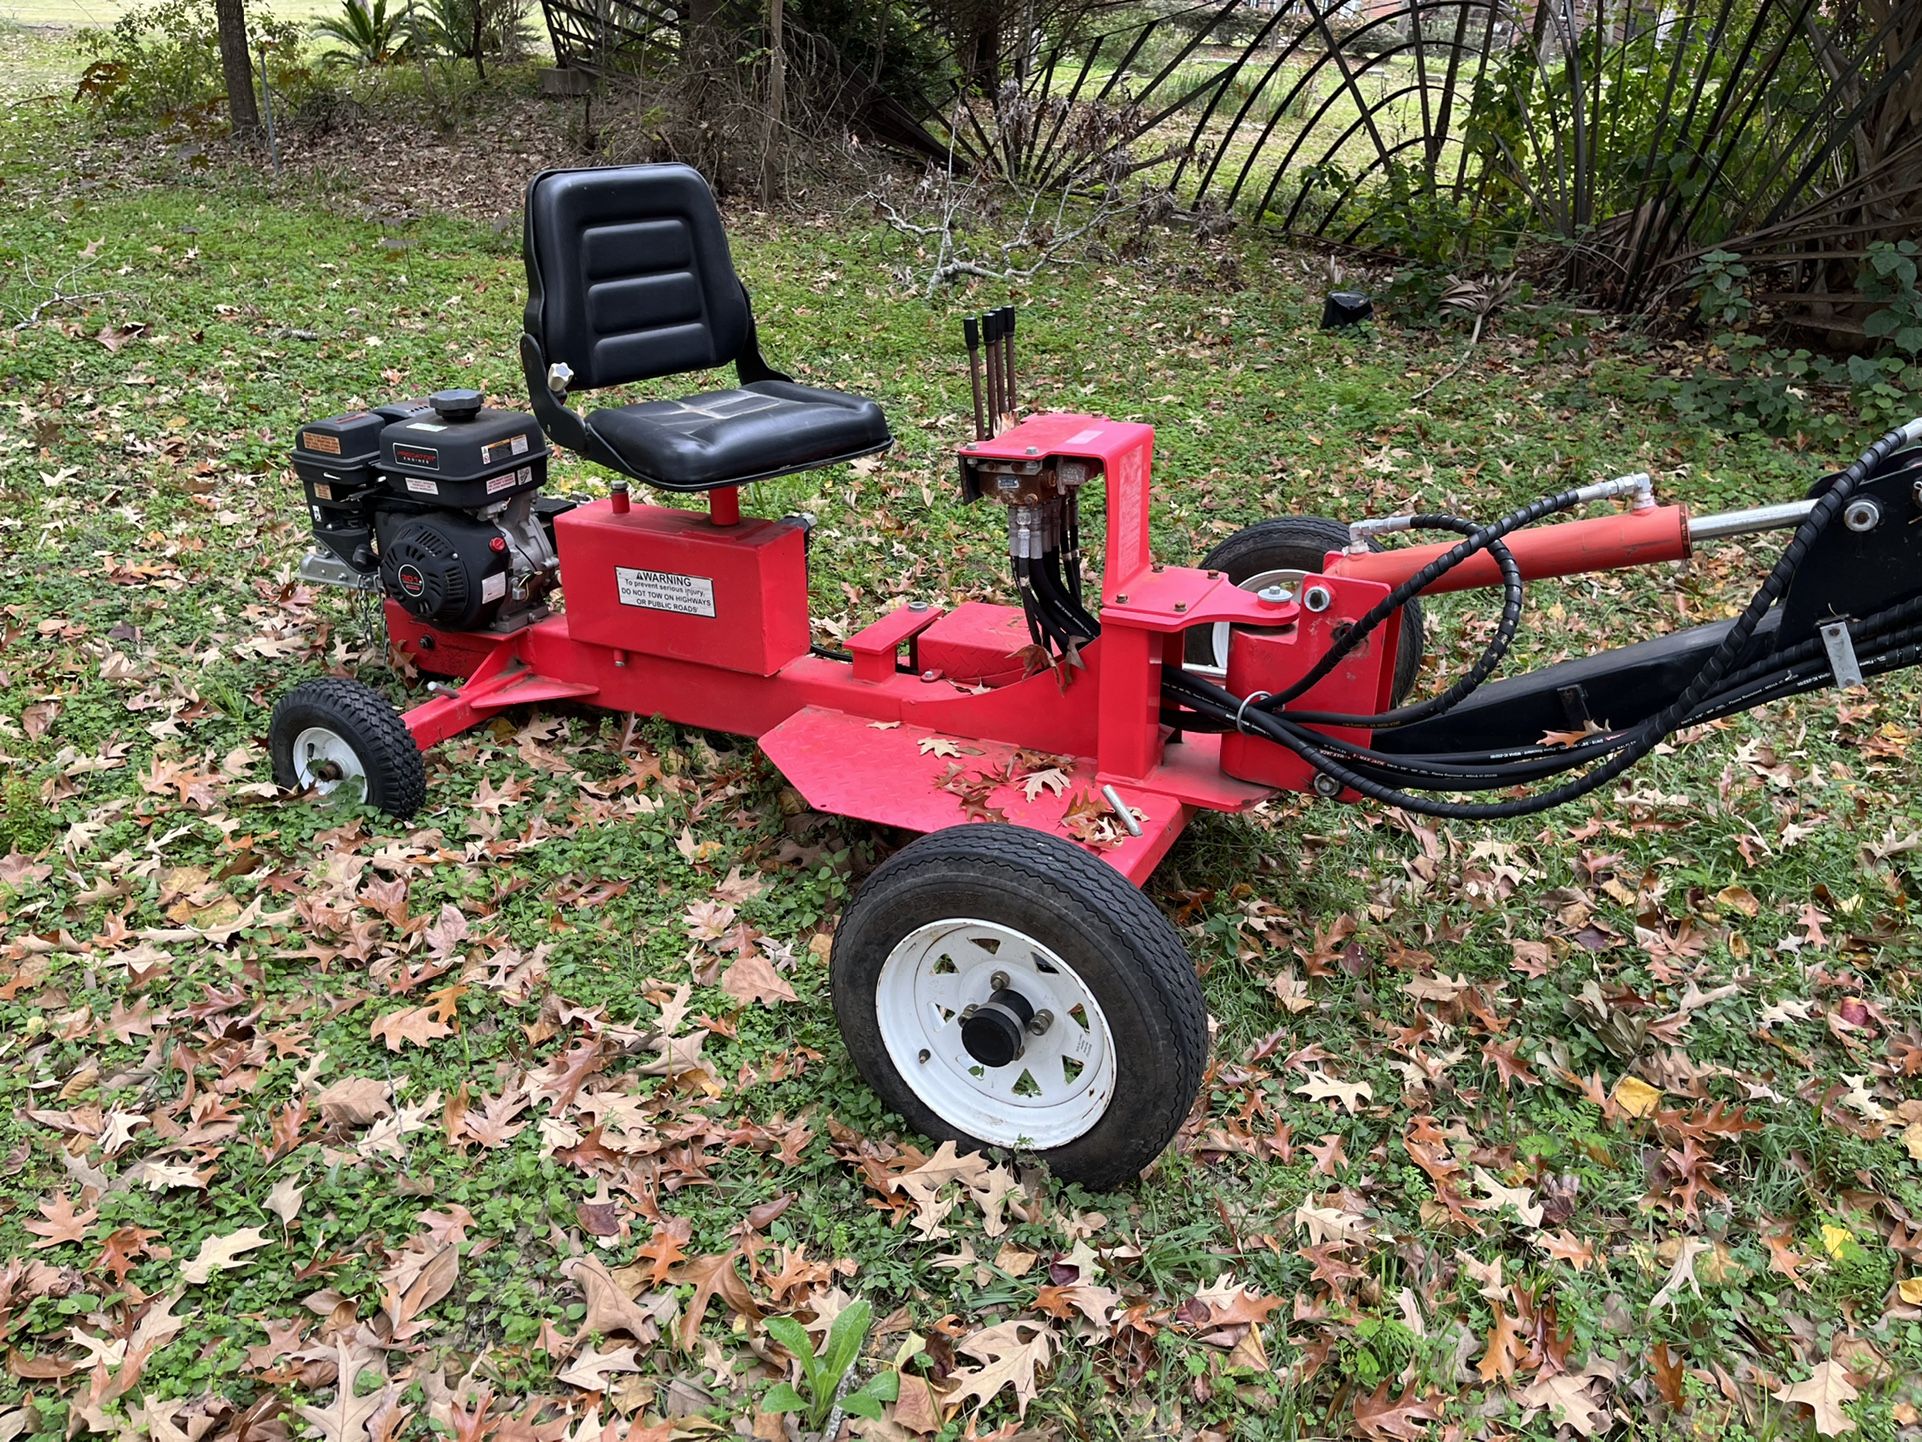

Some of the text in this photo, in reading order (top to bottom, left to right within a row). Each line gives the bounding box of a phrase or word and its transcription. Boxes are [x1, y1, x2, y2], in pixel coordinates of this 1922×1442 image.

[634, 581, 659, 590] prevent
[659, 584, 684, 593] serious
[642, 572, 692, 587] WARNING
[621, 587, 712, 606] DO NOT TOW ON HIGHWAYS
[636, 598, 698, 613] OR PUBLIC ROADS
